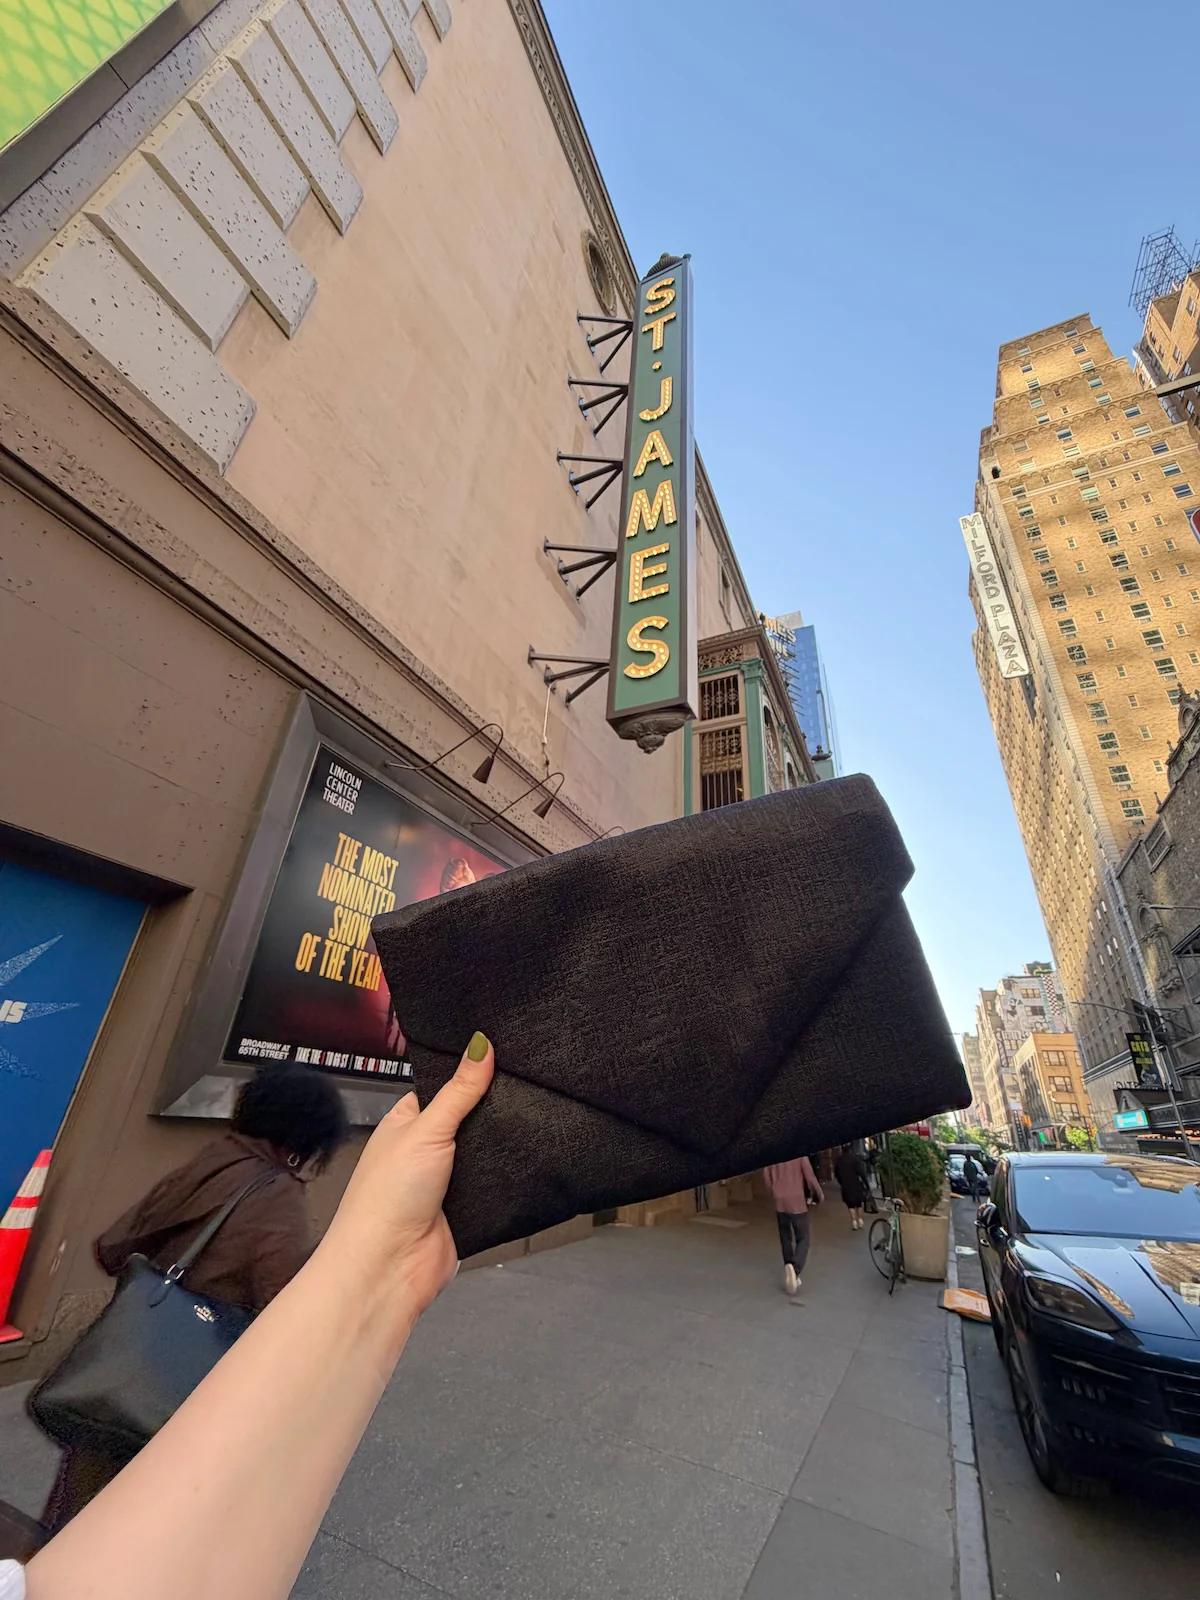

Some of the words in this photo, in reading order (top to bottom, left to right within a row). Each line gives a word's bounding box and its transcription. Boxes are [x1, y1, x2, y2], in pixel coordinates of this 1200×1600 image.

[623, 376, 678, 679] JAMES
[960, 514, 1001, 599] MILFORD
[990, 603, 1026, 675] PLAZA
[326, 776, 359, 803] CENTER
[329, 762, 362, 790] LINCOLN
[322, 787, 355, 816] THEATER
[333, 832, 362, 873] THE
[358, 846, 399, 890] MOST
[328, 905, 373, 950] SHOW
[294, 932, 321, 973] OF
[318, 938, 351, 981] THE
[348, 948, 382, 992] YEAR
[238, 1046, 260, 1056] 65TH
[259, 1048, 290, 1060] STREET
[240, 1038, 282, 1051] BROADWAY
[280, 1044, 291, 1052] AT
[295, 1046, 312, 1063] TAKE
[309, 1048, 322, 1065] THE
[325, 1050, 334, 1066] TO
[340, 1053, 350, 1068] ST
[353, 1055, 365, 1070] THE
[391, 1060, 399, 1075] ST
[402, 1062, 412, 1076] THE
